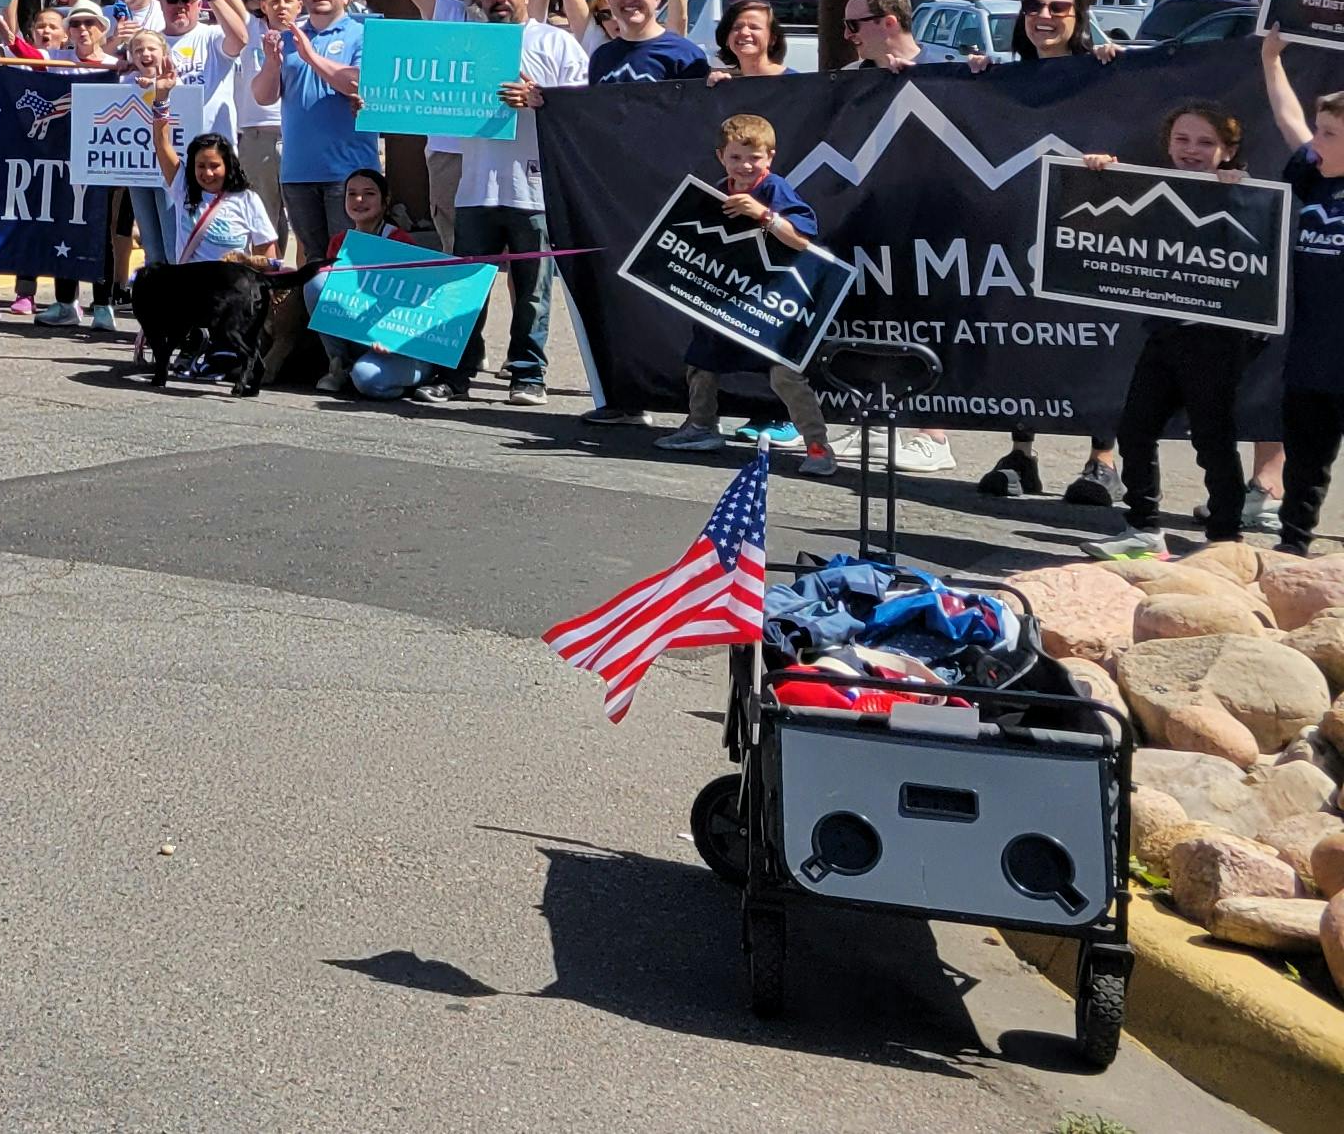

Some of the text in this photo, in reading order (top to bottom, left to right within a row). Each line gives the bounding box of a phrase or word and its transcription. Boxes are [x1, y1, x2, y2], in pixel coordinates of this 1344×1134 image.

[393, 58, 475, 83] JULIE
[363, 85, 496, 105] DURAN MULLIC
[416, 106, 510, 118] COMMISSIONER
[88, 127, 185, 150] JACQE
[87, 151, 185, 170] PHILLIS
[1300, 229, 1344, 246] MASO
[1056, 226, 1268, 276] BRIAN MASON
[656, 229, 726, 280] BRIAN
[725, 268, 817, 328] MASON
[1083, 259, 1240, 290] FOR DISTRICT ATTORNEY
[324, 289, 384, 313] DURAN
[355, 270, 439, 310] JULIE
[667, 261, 785, 328] FOR DISTRICT ATTORNEY
[1098, 283, 1222, 309] www.BrianMason.us
[669, 283, 761, 337] www.BrianMason.us
[823, 319, 1120, 347] DISTRICT ATTORNEY
